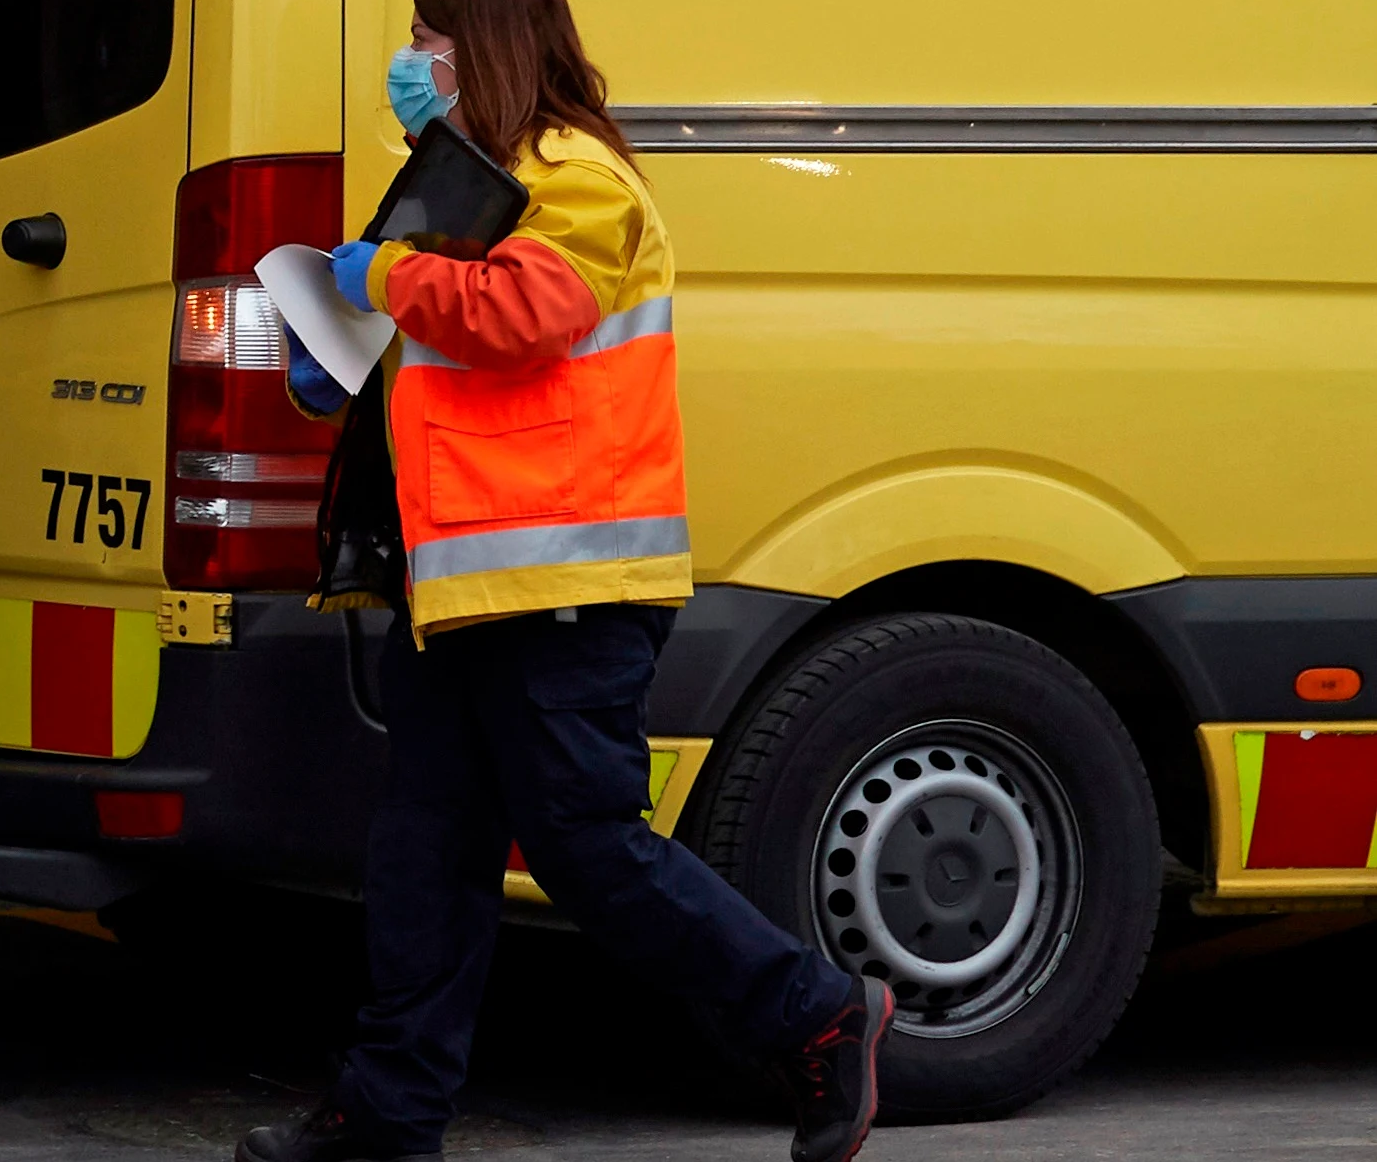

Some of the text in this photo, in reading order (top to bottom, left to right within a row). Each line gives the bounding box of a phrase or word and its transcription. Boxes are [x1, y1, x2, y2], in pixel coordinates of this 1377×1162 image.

[51, 378, 146, 406] 313 CDI
[41, 469, 151, 551] 7757
